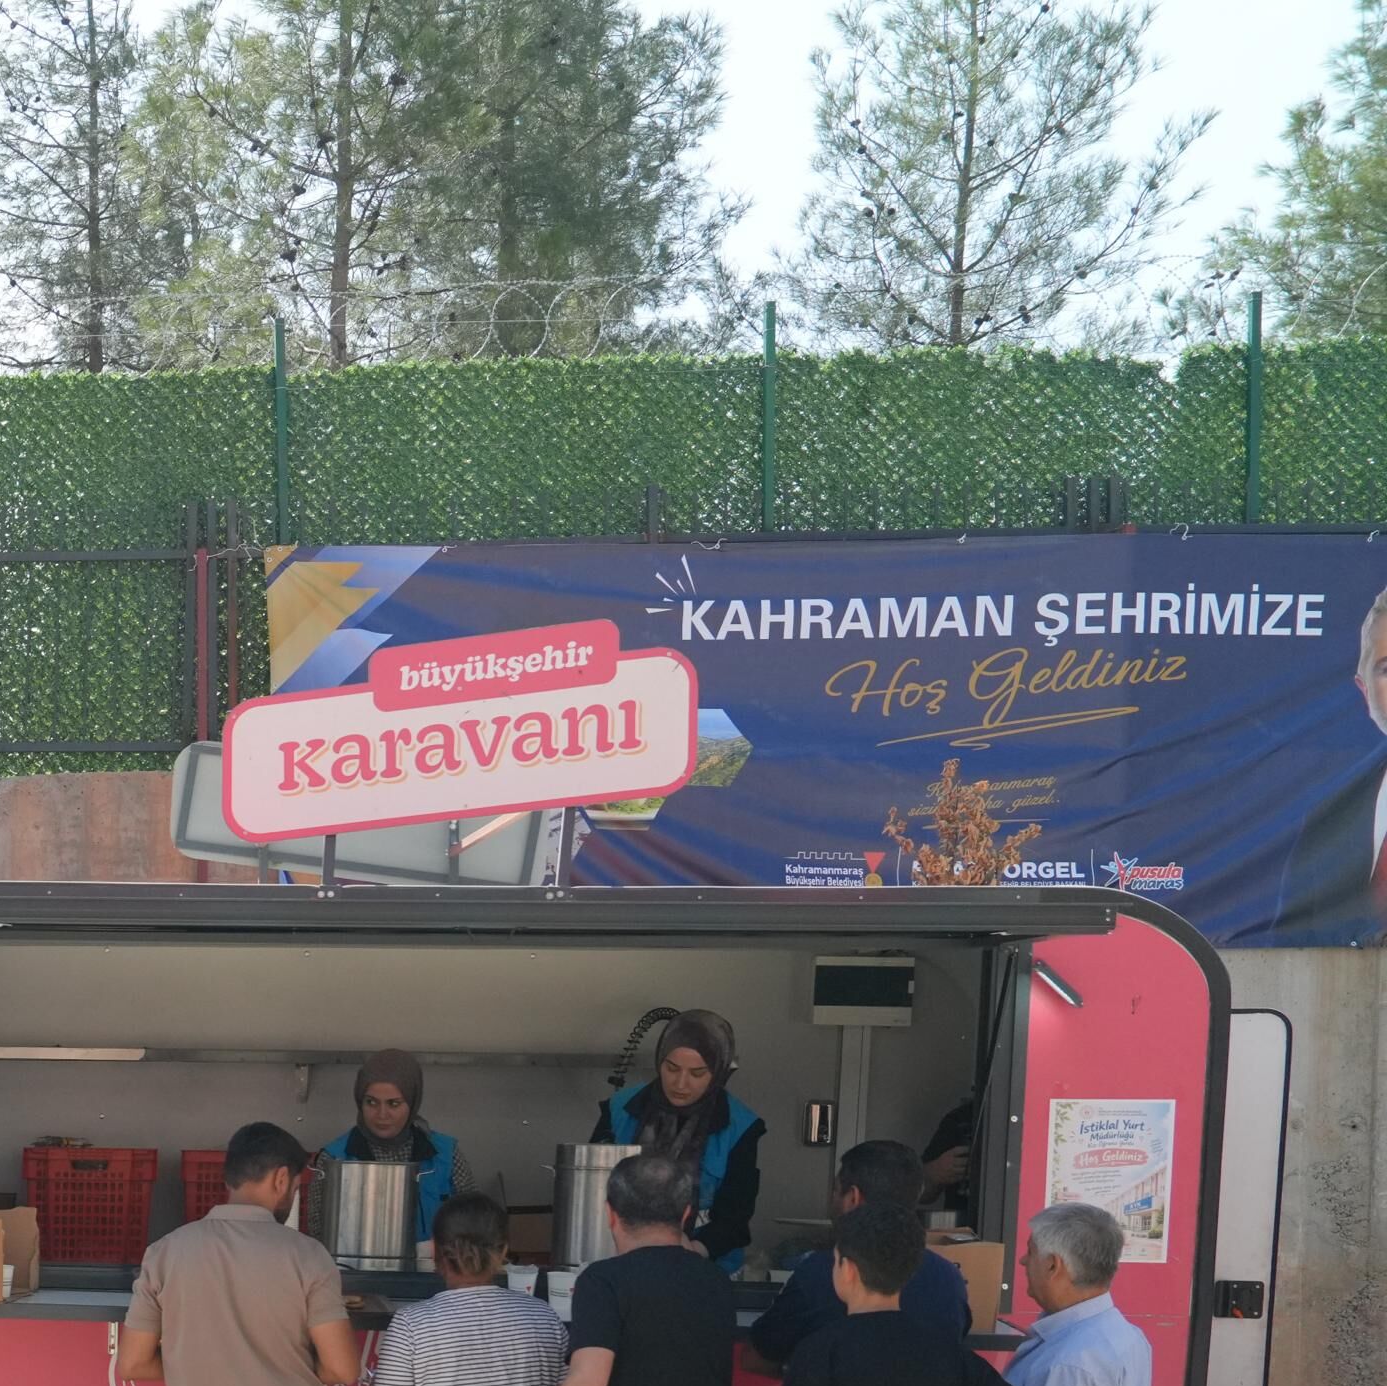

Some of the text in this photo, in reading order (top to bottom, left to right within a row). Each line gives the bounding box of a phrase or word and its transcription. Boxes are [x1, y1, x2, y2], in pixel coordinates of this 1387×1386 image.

[680, 582, 1324, 648] KAHRAMAN ŞEHRİMİZE
[399, 641, 594, 692] büyükşehir
[825, 647, 1187, 727] Hoş Geldiniz
[785, 864, 864, 878] Kahramanmaraş
[785, 875, 864, 887] Büyükşehir Belediyesi
[1125, 862, 1183, 884] pusula
[1123, 1119, 1145, 1131] Yurt
